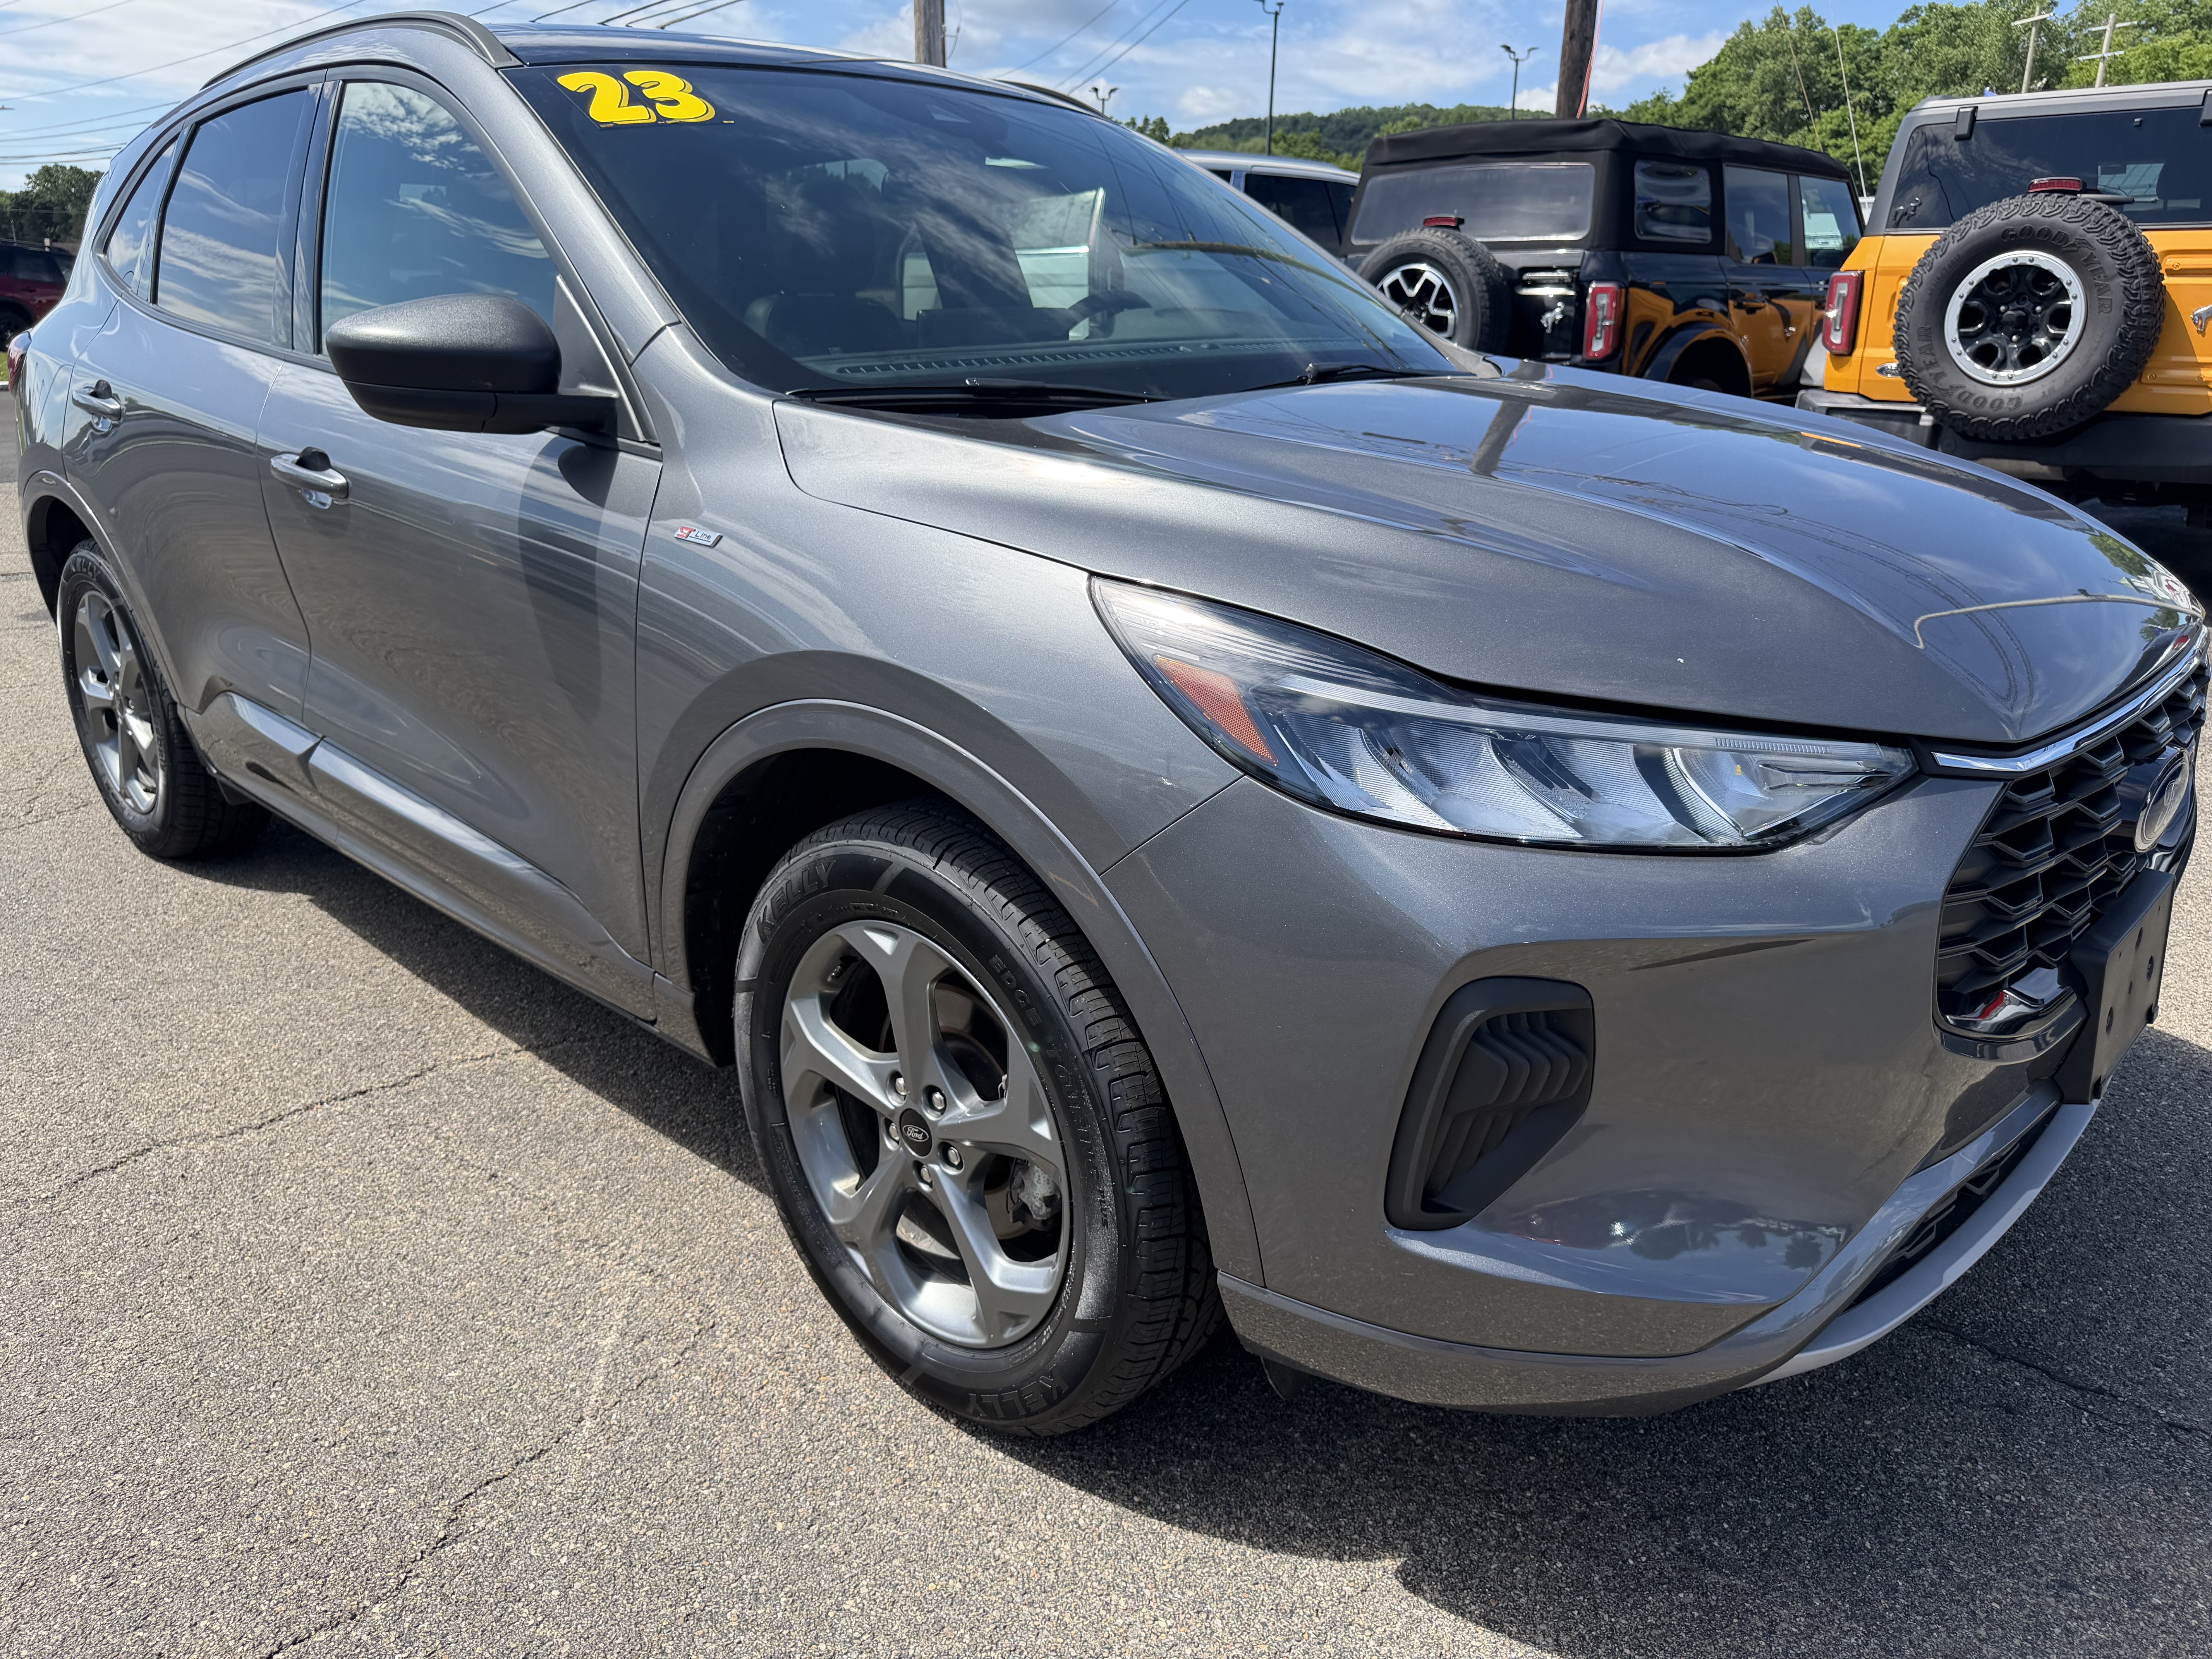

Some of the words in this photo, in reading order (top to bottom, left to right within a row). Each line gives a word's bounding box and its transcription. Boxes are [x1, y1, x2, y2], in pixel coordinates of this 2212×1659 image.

[557, 70, 715, 125] 23
[756, 859, 836, 944] KELLY
[988, 954, 1043, 1027] EDGE
[907, 1126, 924, 1140] Ford
[967, 1363, 1070, 1418] KELLY
